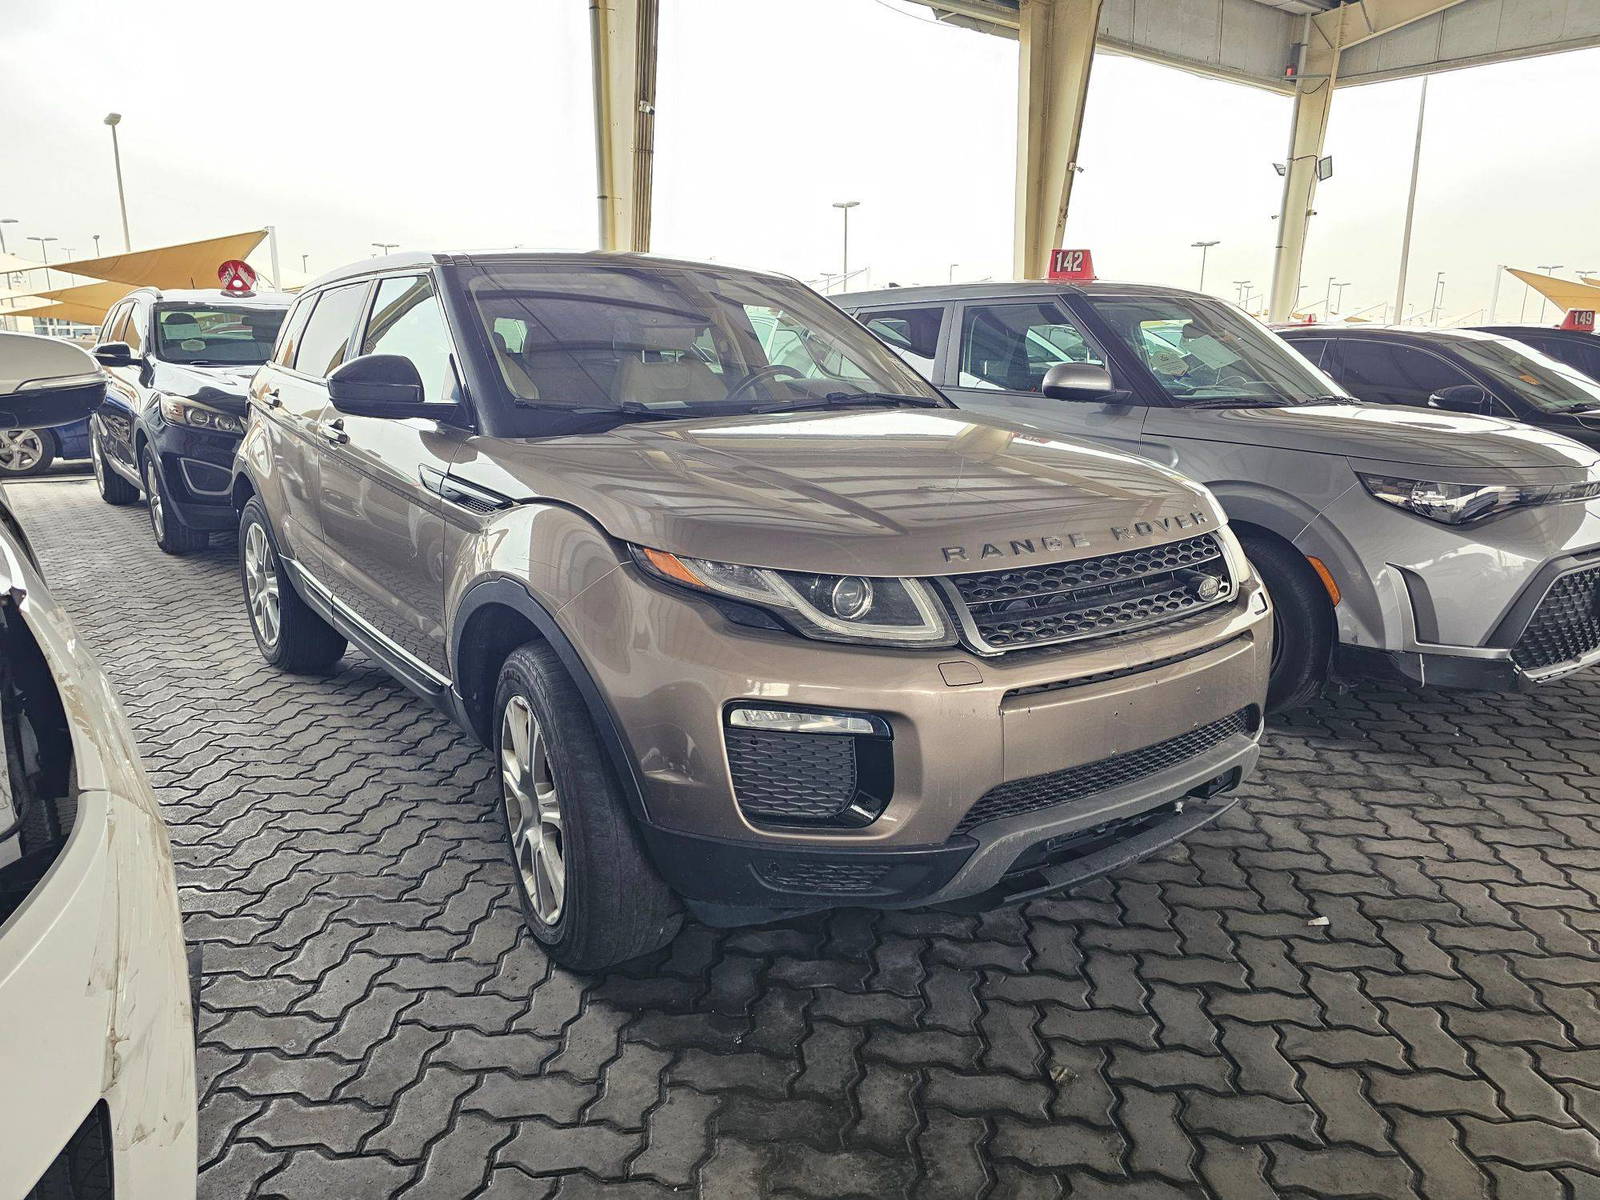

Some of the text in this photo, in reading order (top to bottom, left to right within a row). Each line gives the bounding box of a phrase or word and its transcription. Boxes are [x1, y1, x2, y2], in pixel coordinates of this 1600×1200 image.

[1056, 251, 1083, 272] 142
[1574, 311, 1593, 325] 149
[941, 511, 1208, 563] RANGE ROVER
